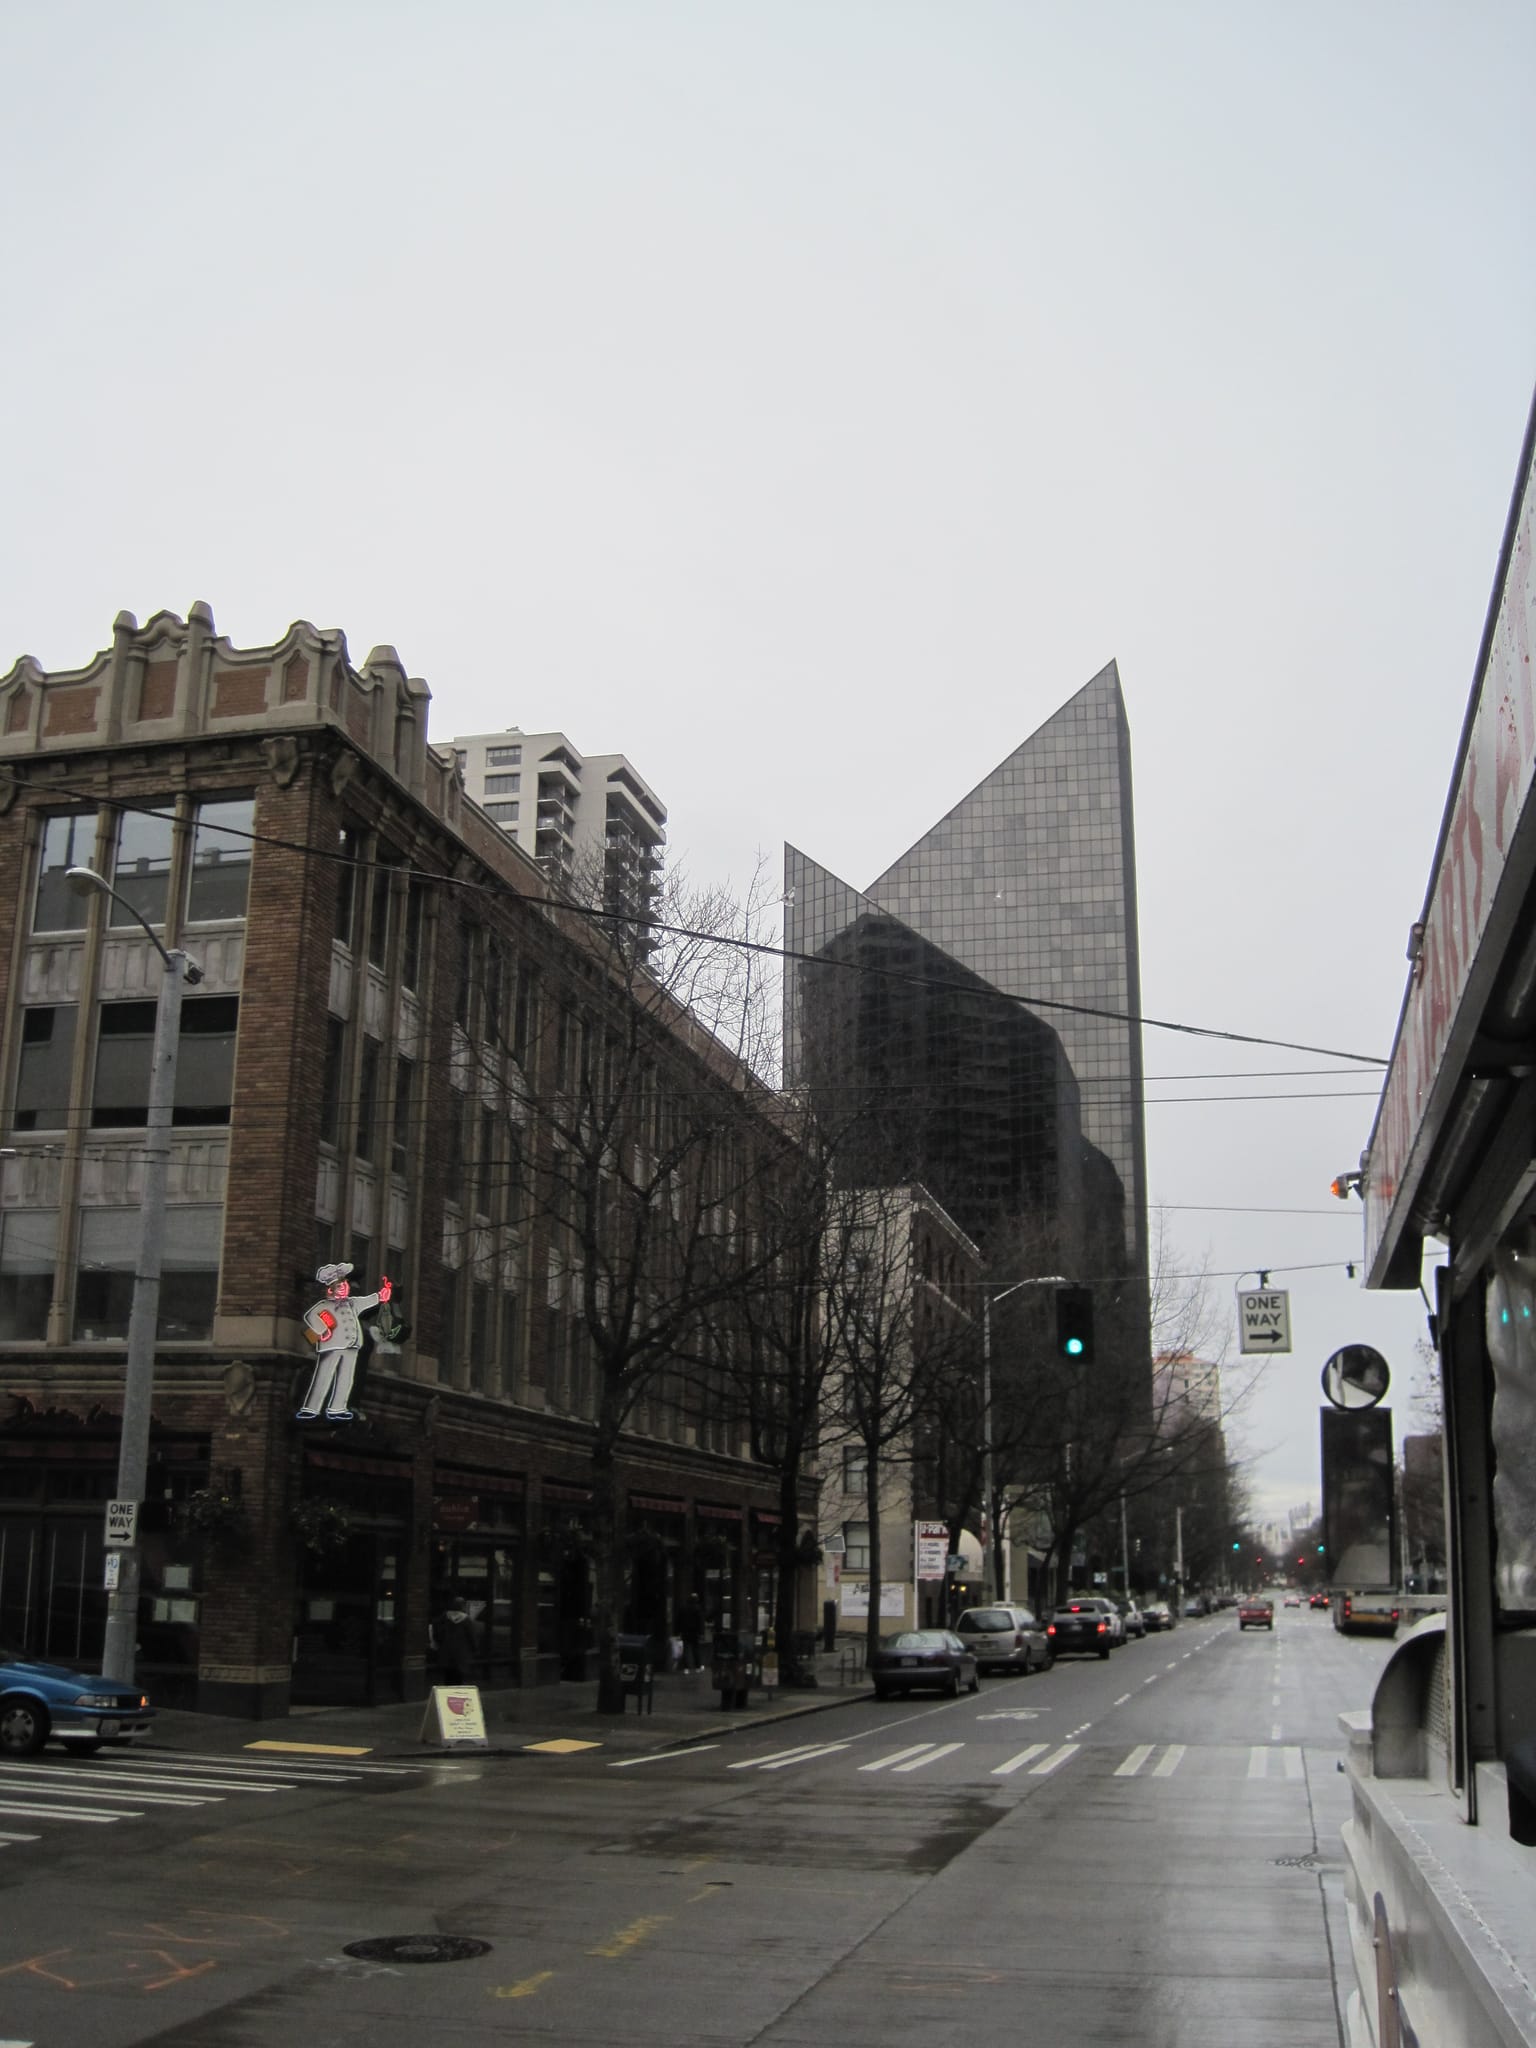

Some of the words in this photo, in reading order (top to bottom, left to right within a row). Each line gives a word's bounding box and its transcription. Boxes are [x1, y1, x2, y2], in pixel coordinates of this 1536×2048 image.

[1414, 743, 1484, 1116] STARTS
[1246, 1296, 1281, 1310] ONE
[1246, 1313, 1282, 1326] WAY
[110, 1503, 134, 1515] ONE
[109, 1517, 133, 1528] WAY
